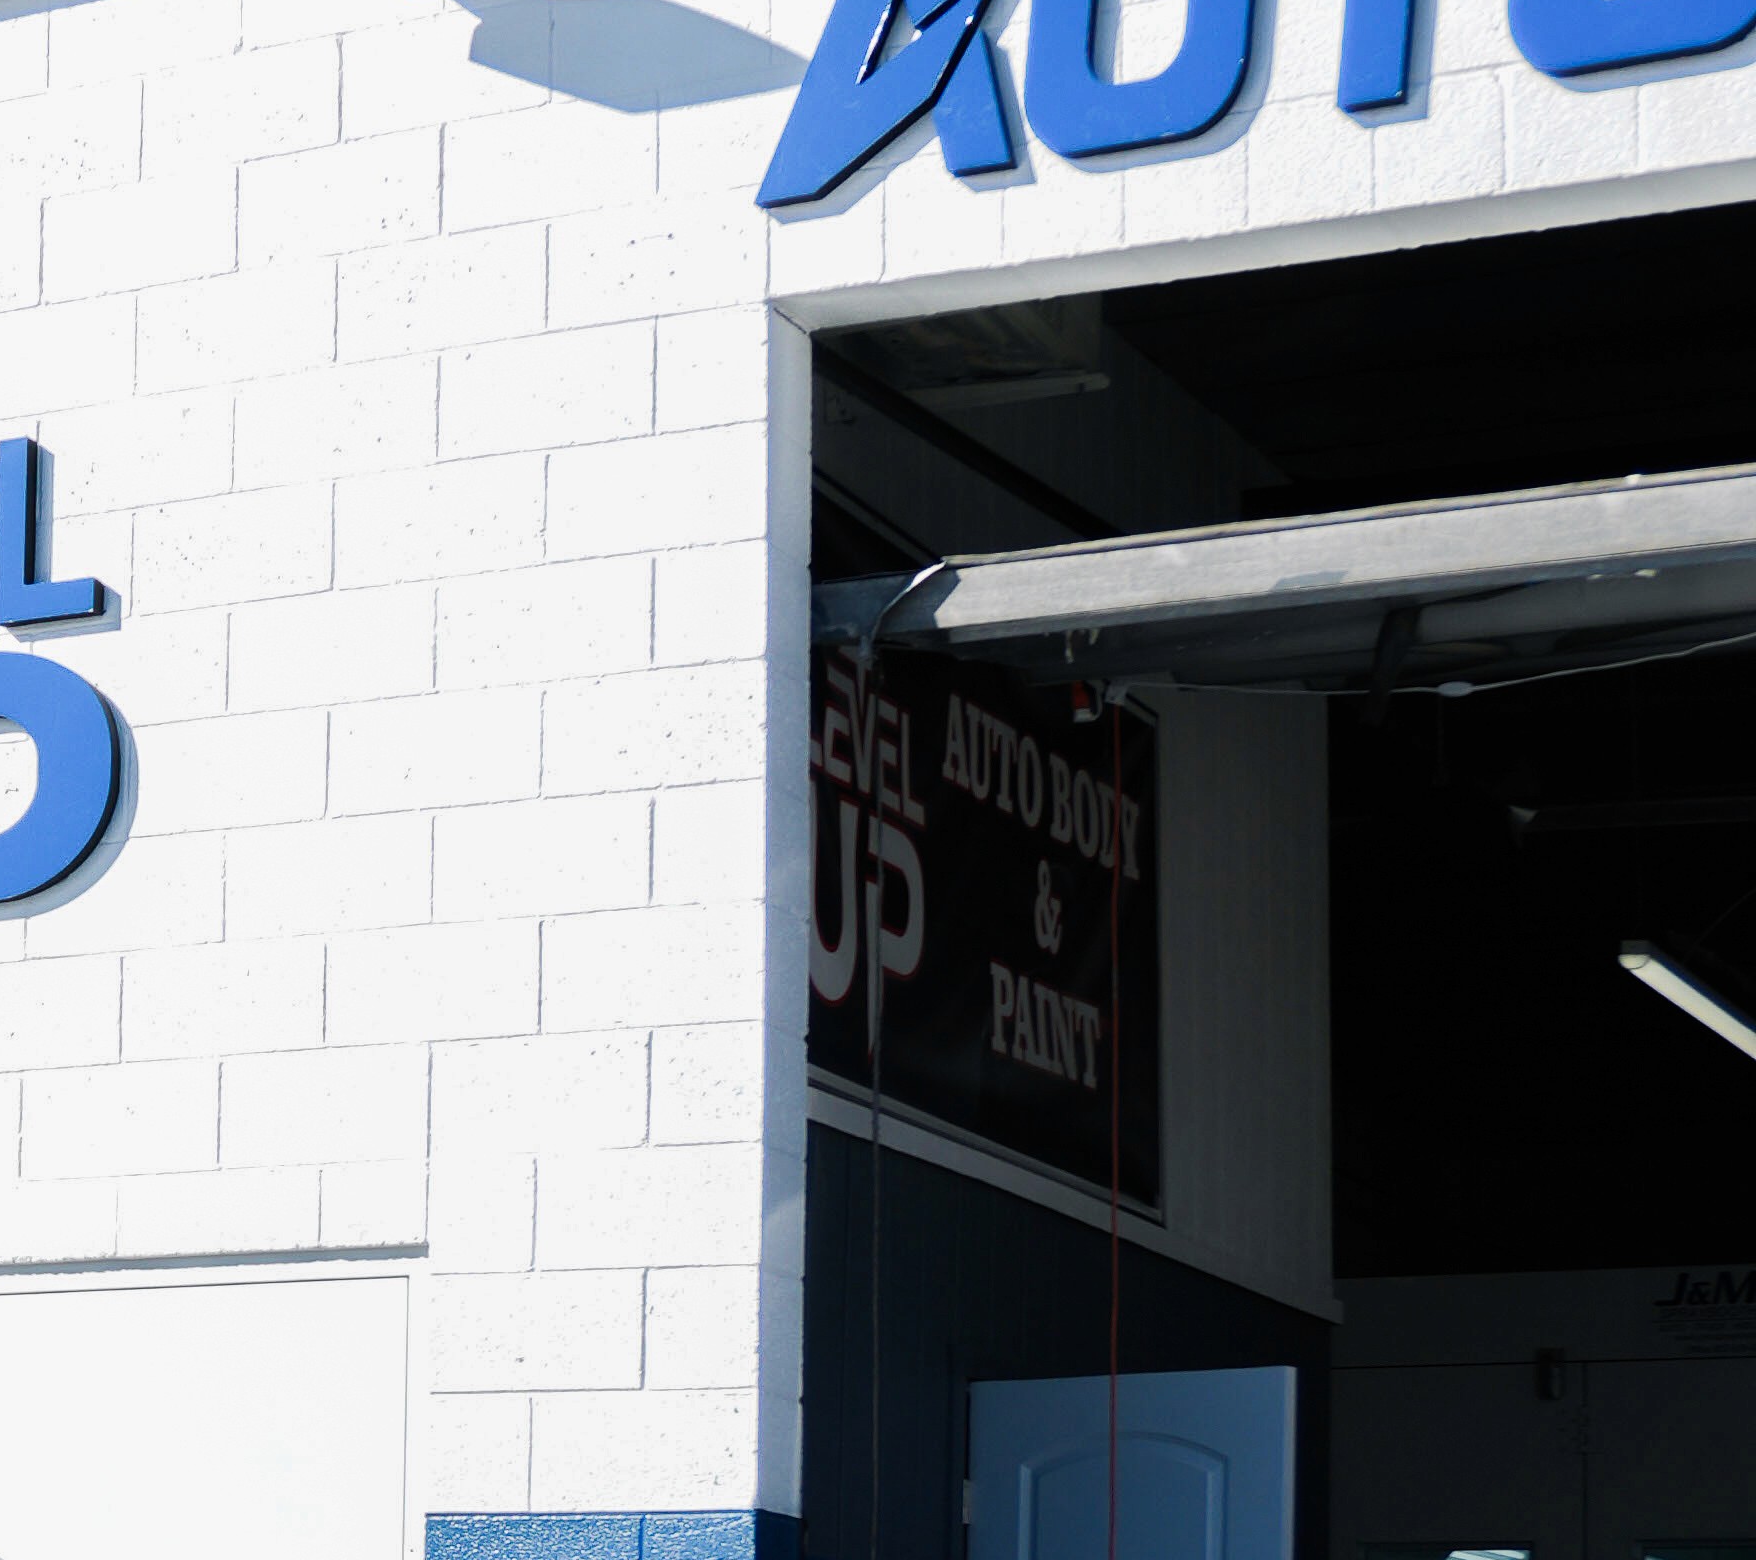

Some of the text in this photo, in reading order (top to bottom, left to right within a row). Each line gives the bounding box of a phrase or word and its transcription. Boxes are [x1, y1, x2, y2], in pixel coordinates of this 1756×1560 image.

[810, 658, 925, 828] EVEL
[941, 692, 1141, 881] AUTO BODY
[810, 797, 926, 1052] UP
[1033, 858, 1063, 956] &
[989, 960, 1101, 1089] PAINT
